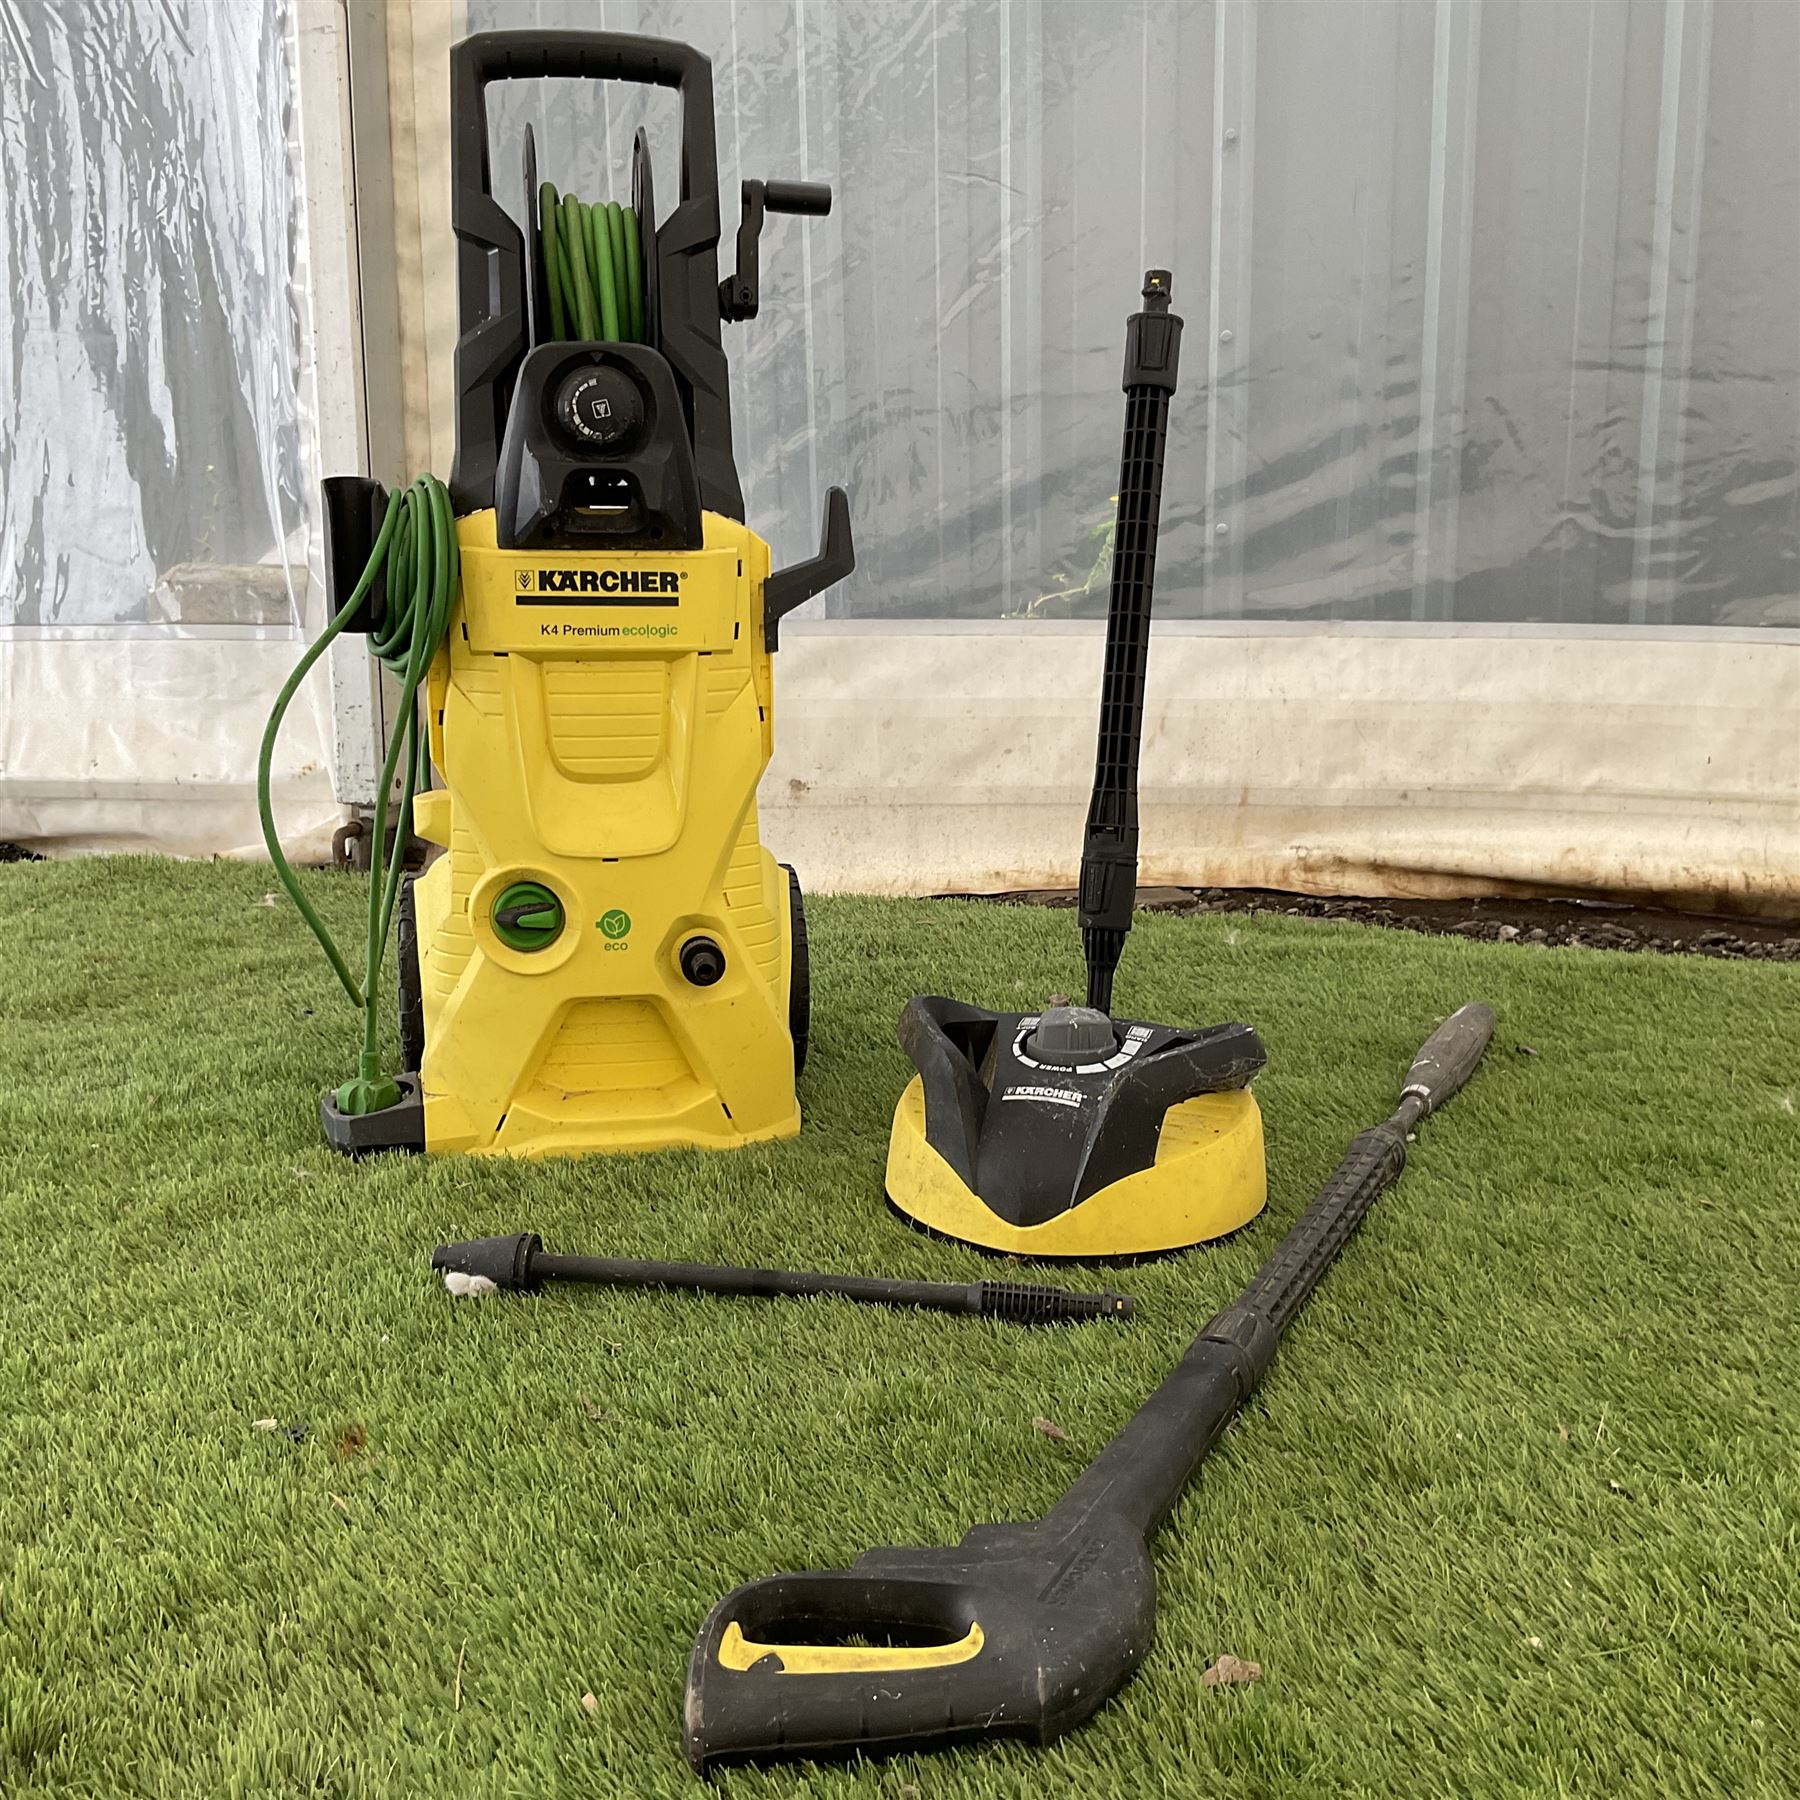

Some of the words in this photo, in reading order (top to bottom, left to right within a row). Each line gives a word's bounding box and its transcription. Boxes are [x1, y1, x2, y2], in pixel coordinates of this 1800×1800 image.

[538, 570, 679, 592] KÄRCHER
[541, 625, 558, 636] K4
[563, 625, 620, 636] Premium
[622, 624, 678, 638] ecologic
[604, 942, 628, 951] eco
[1039, 1063, 1073, 1073] POWER
